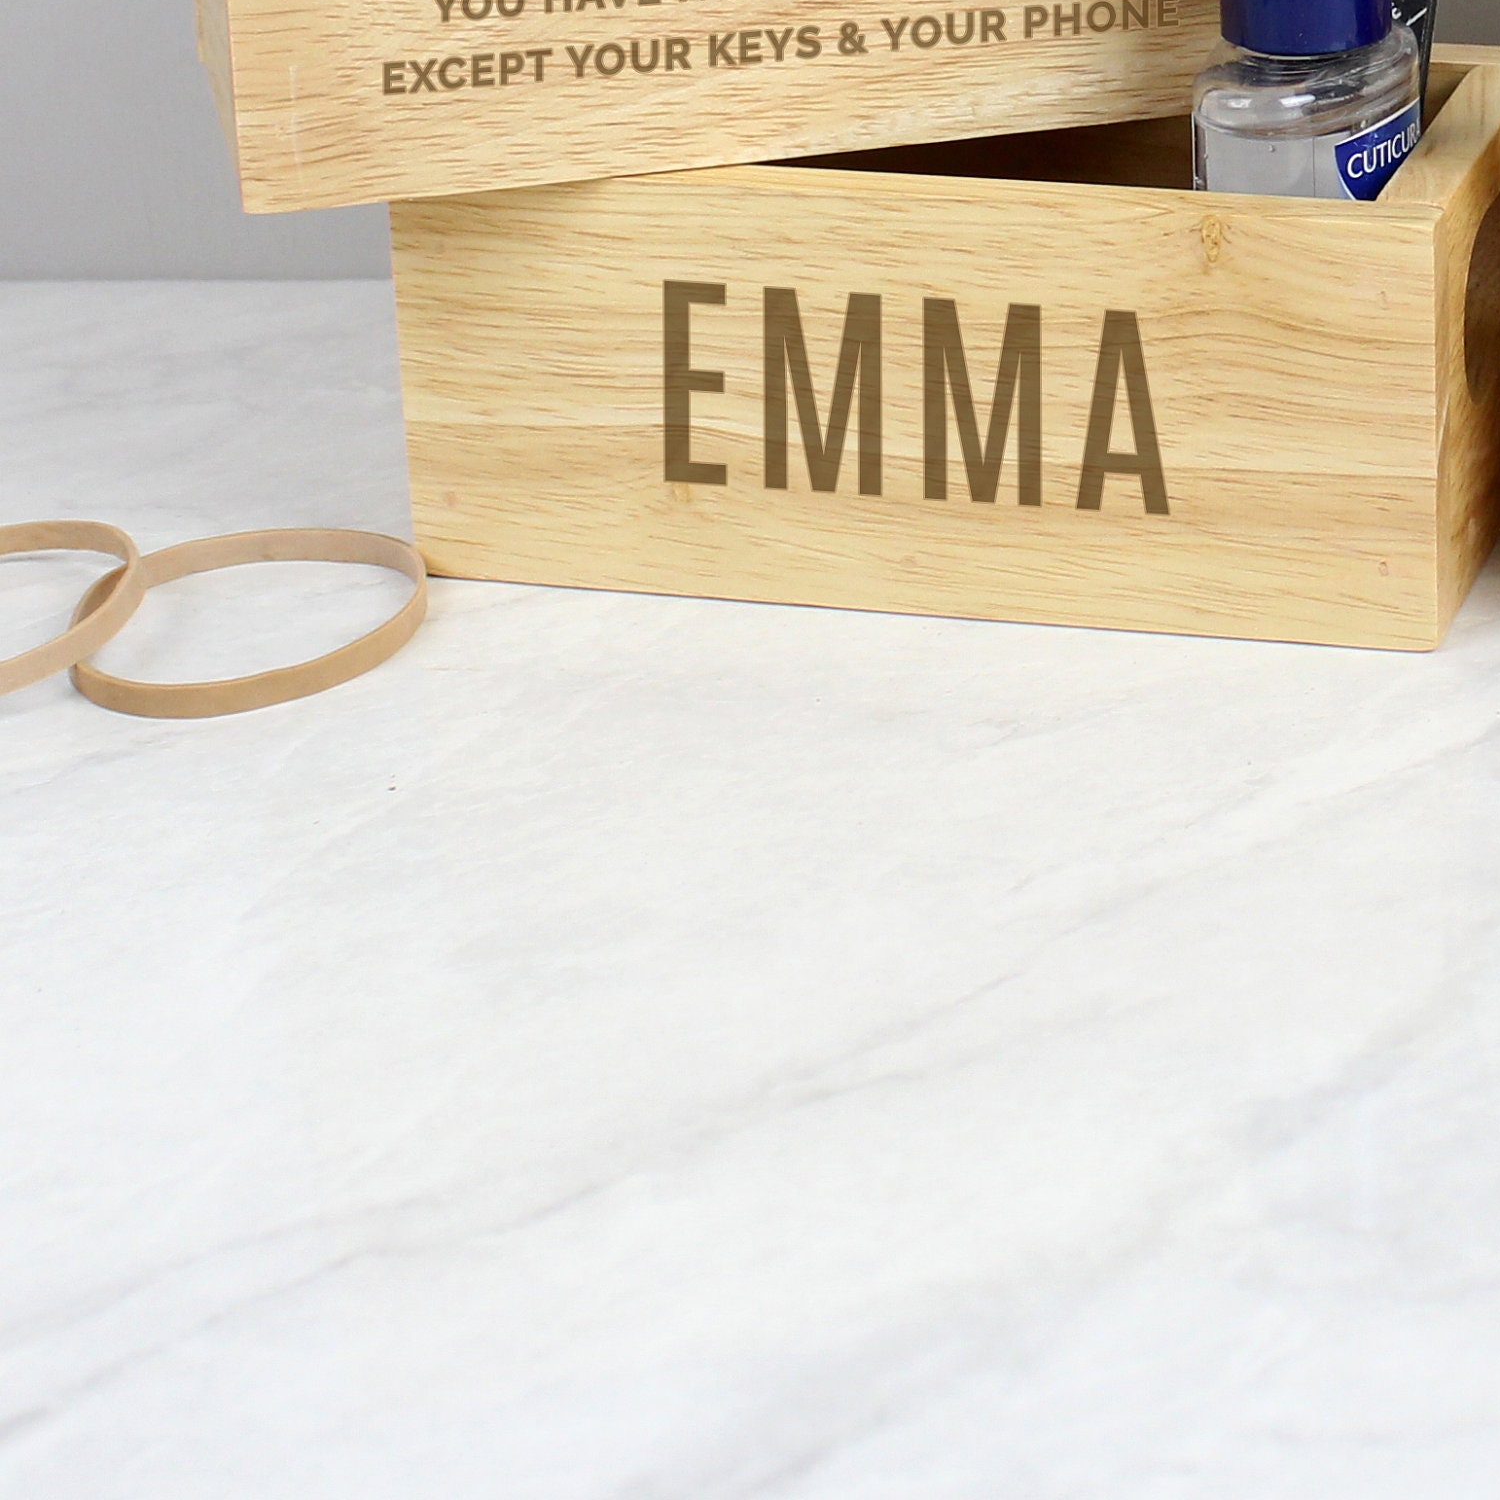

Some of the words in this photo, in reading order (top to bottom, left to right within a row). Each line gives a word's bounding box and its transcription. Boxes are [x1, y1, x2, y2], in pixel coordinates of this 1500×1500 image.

[382, 47, 554, 96] EXCEPT
[565, 36, 692, 79] YOUR
[708, 25, 822, 68] KEYS
[837, 21, 869, 57] &
[880, 8, 1007, 52] YOUR
[662, 279, 1172, 517] EMMA
